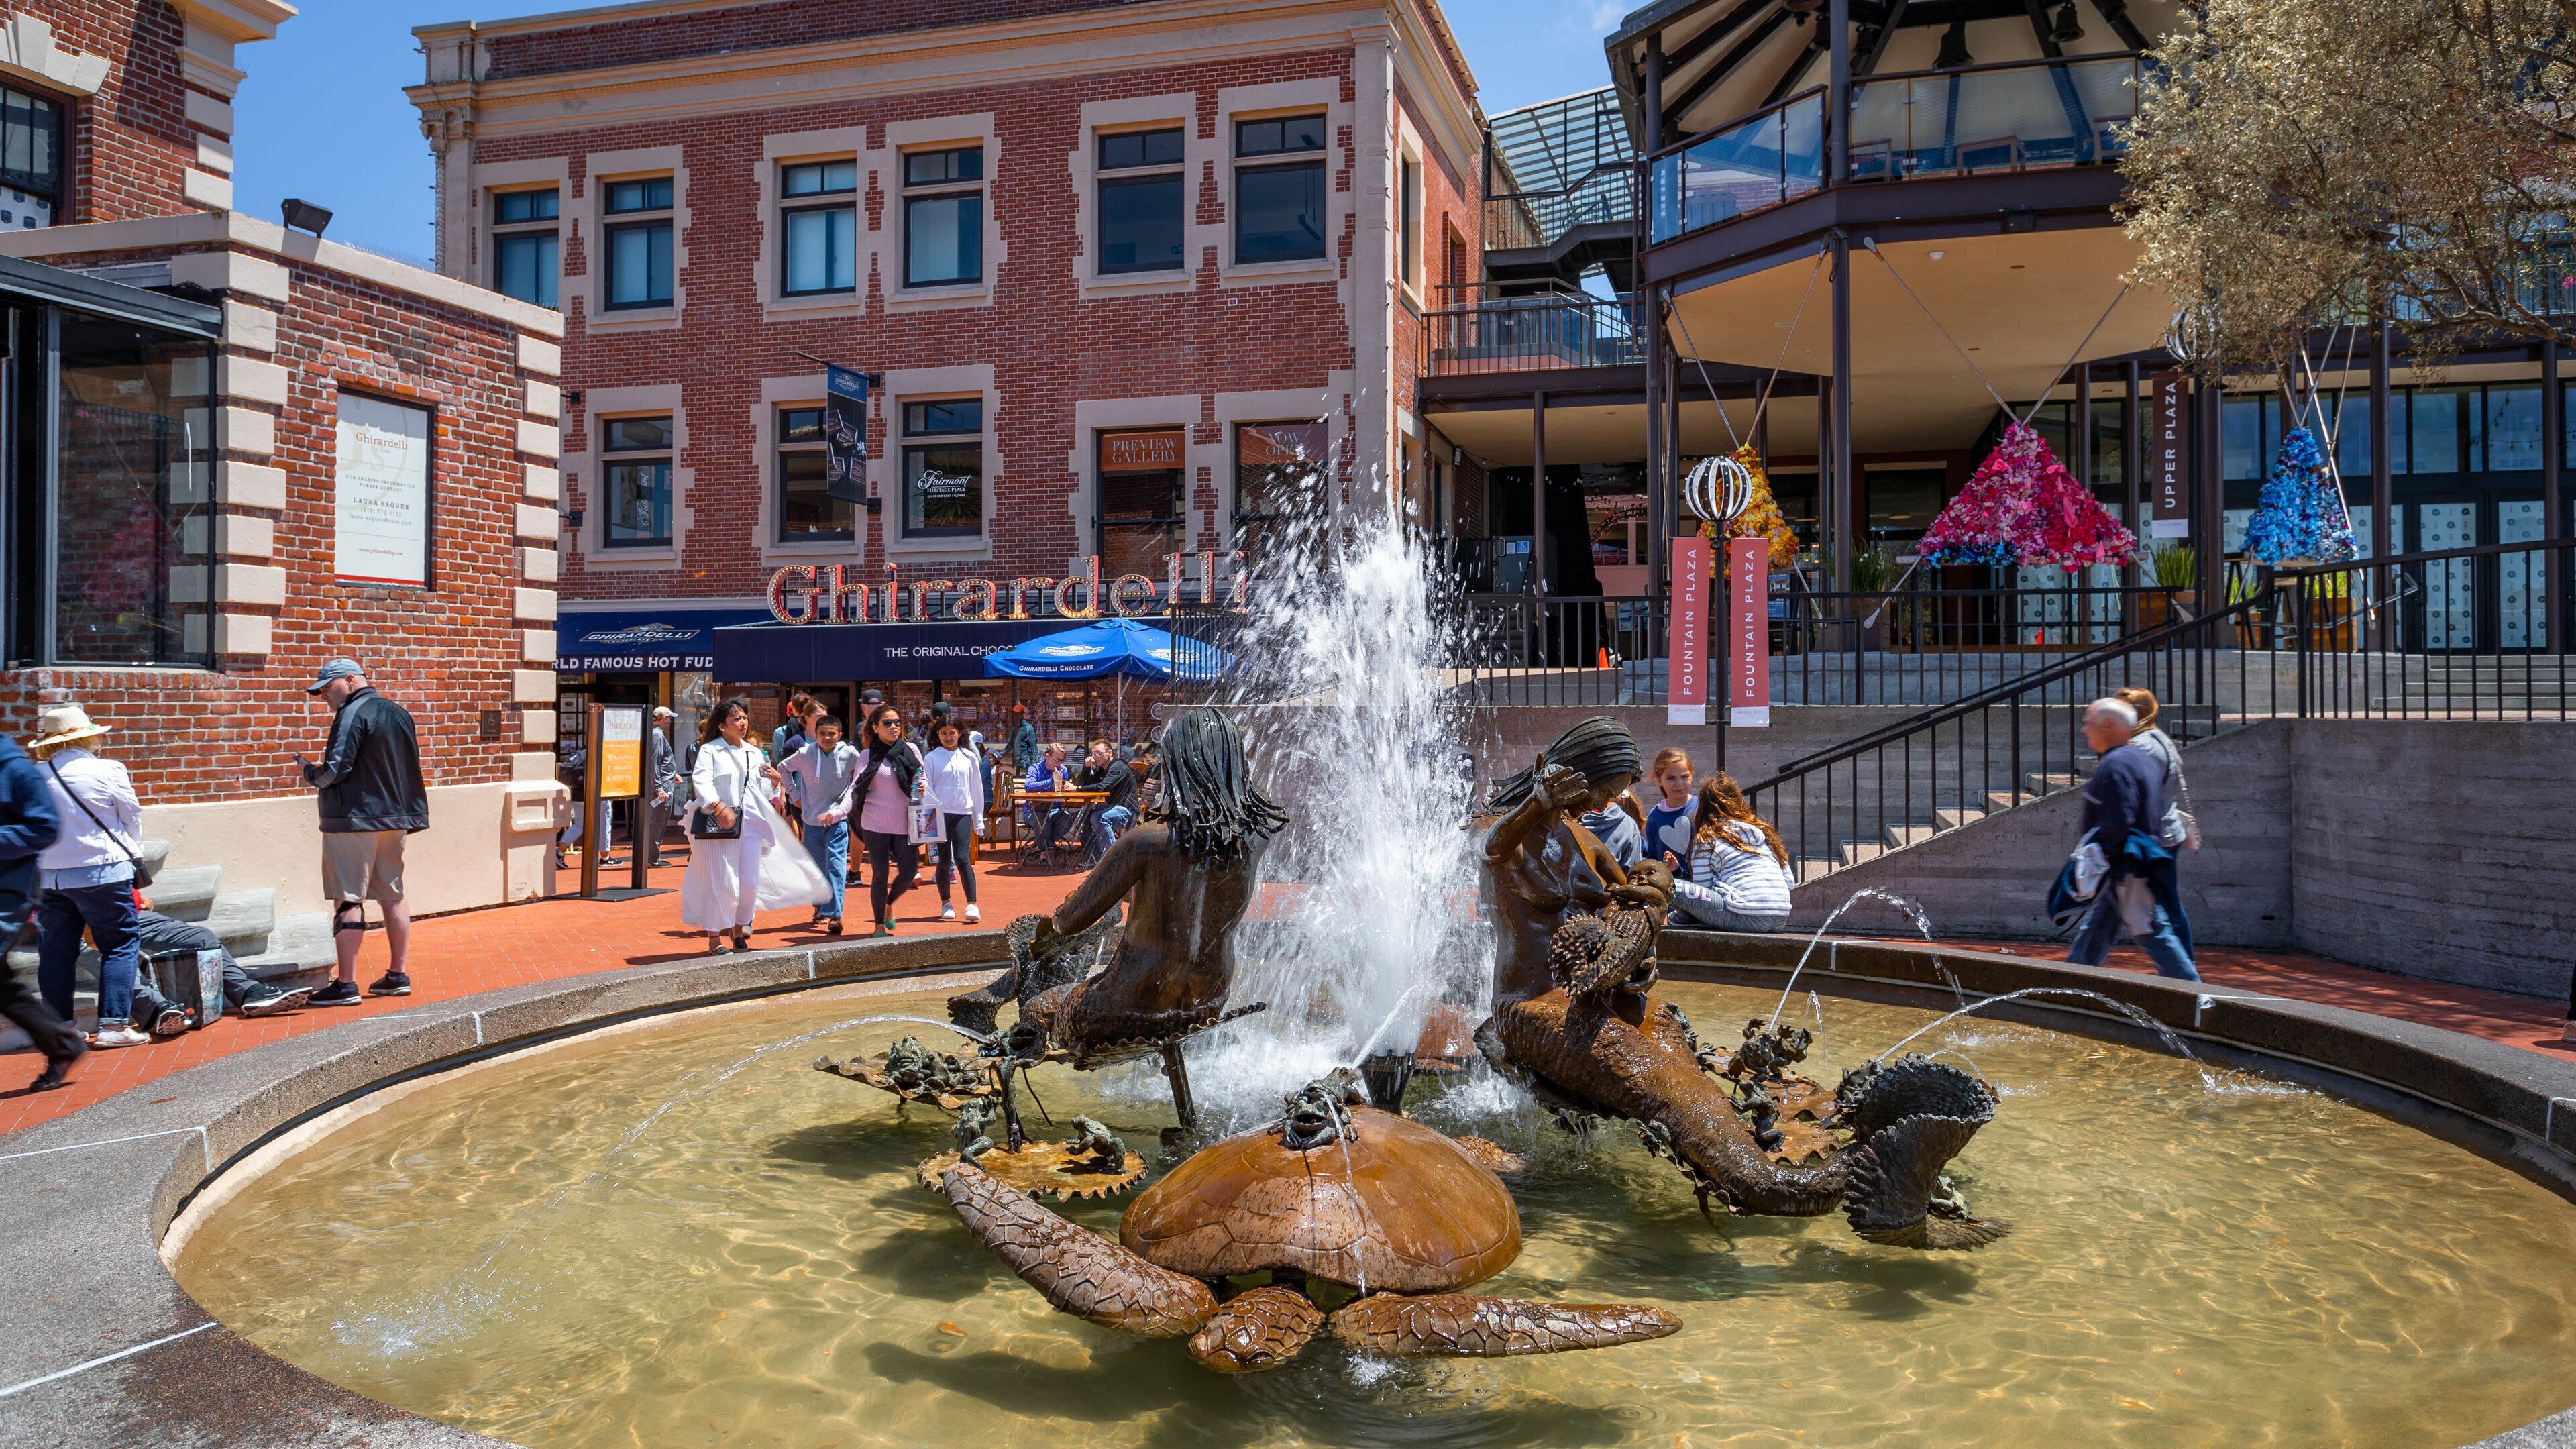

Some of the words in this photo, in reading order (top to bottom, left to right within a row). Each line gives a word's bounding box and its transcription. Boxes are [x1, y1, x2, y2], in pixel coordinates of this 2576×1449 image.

[2165, 382, 2176, 439] PLAZA
[356, 432, 408, 451] Ghirardelli
[1112, 438, 1178, 451] PREVIEW
[1267, 431, 1300, 443] NOW
[1112, 449, 1179, 464] GALLERY
[357, 475, 380, 484] LEASING
[918, 470, 973, 490] Fairmont
[2165, 449, 2176, 508] UPPER
[353, 497, 378, 506] LAURA
[380, 500, 410, 511] SAGUES
[1686, 549, 1697, 602] PLAZA
[1745, 550, 1755, 603] PLAZA
[767, 551, 1246, 625] Ghirardelli
[588, 631, 694, 640] GHIRARDELLI
[883, 647, 909, 657] THE
[912, 646, 970, 657] ORIGINAL
[1683, 611, 1694, 696] FOUNTAIN
[1746, 612, 1755, 698] FOUNTAIN
[584, 657, 644, 669] FAMOUS
[647, 656, 680, 668] HOT
